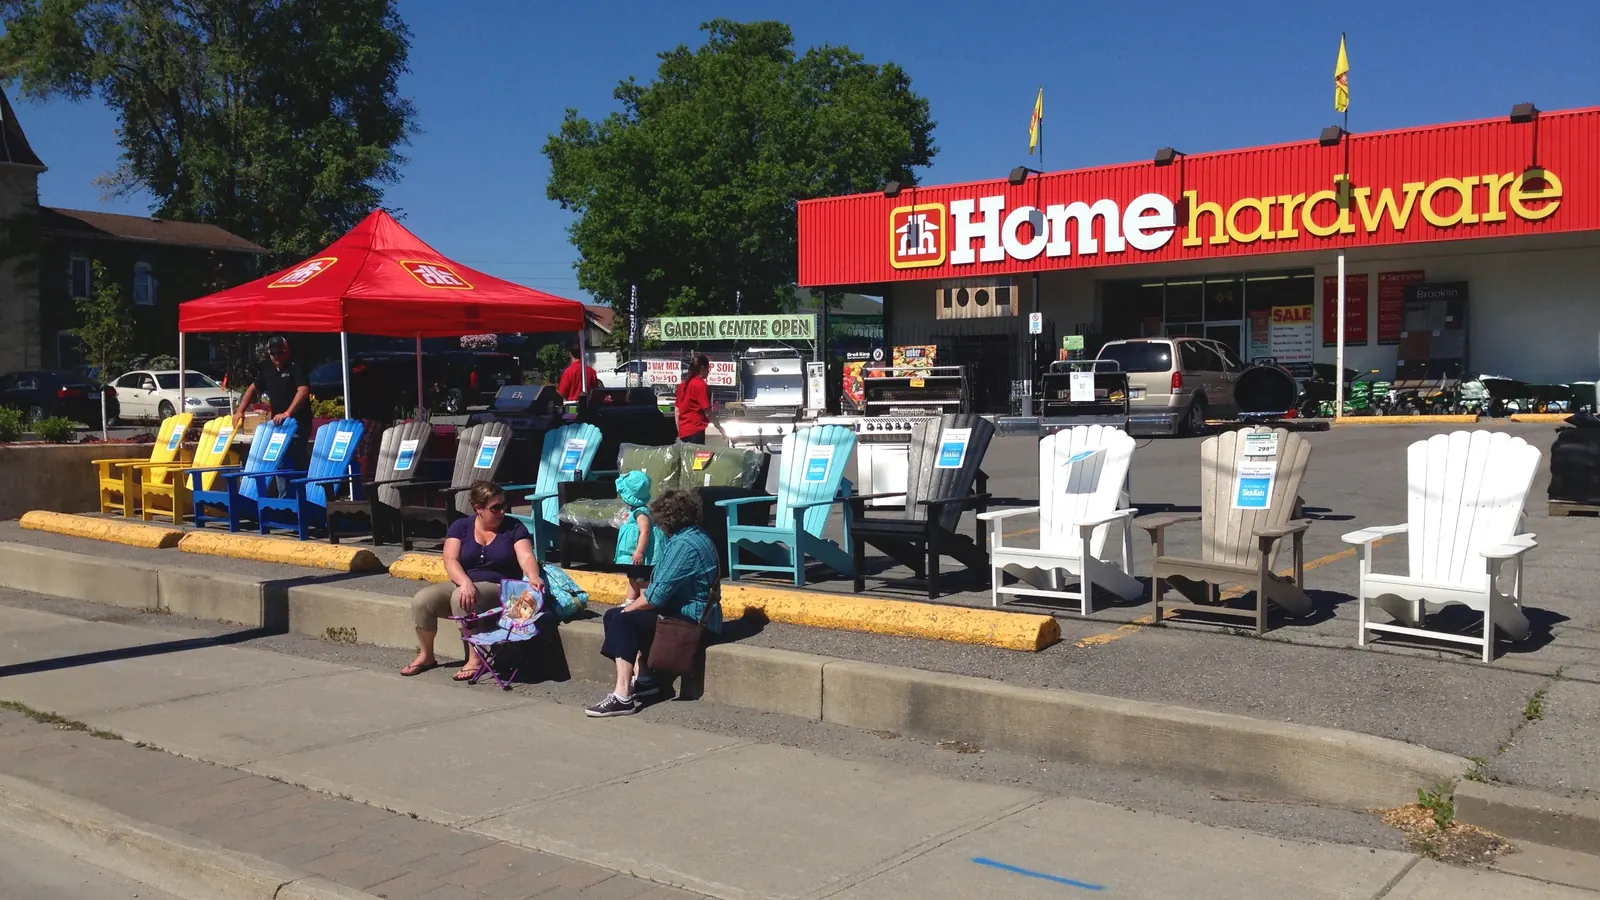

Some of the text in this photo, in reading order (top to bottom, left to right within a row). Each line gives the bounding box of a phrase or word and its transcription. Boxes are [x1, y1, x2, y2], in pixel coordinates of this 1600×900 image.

[950, 168, 1563, 265] Home hardware
[1416, 289, 1458, 298] Brooklin
[1273, 307, 1311, 322] SALE
[664, 319, 809, 338] GARDEN CENTRE OPEN
[648, 362, 680, 370] 3 WAY MIX
[716, 363, 735, 372] SOIL
[663, 375, 677, 383] $10
[717, 376, 732, 384] $10
